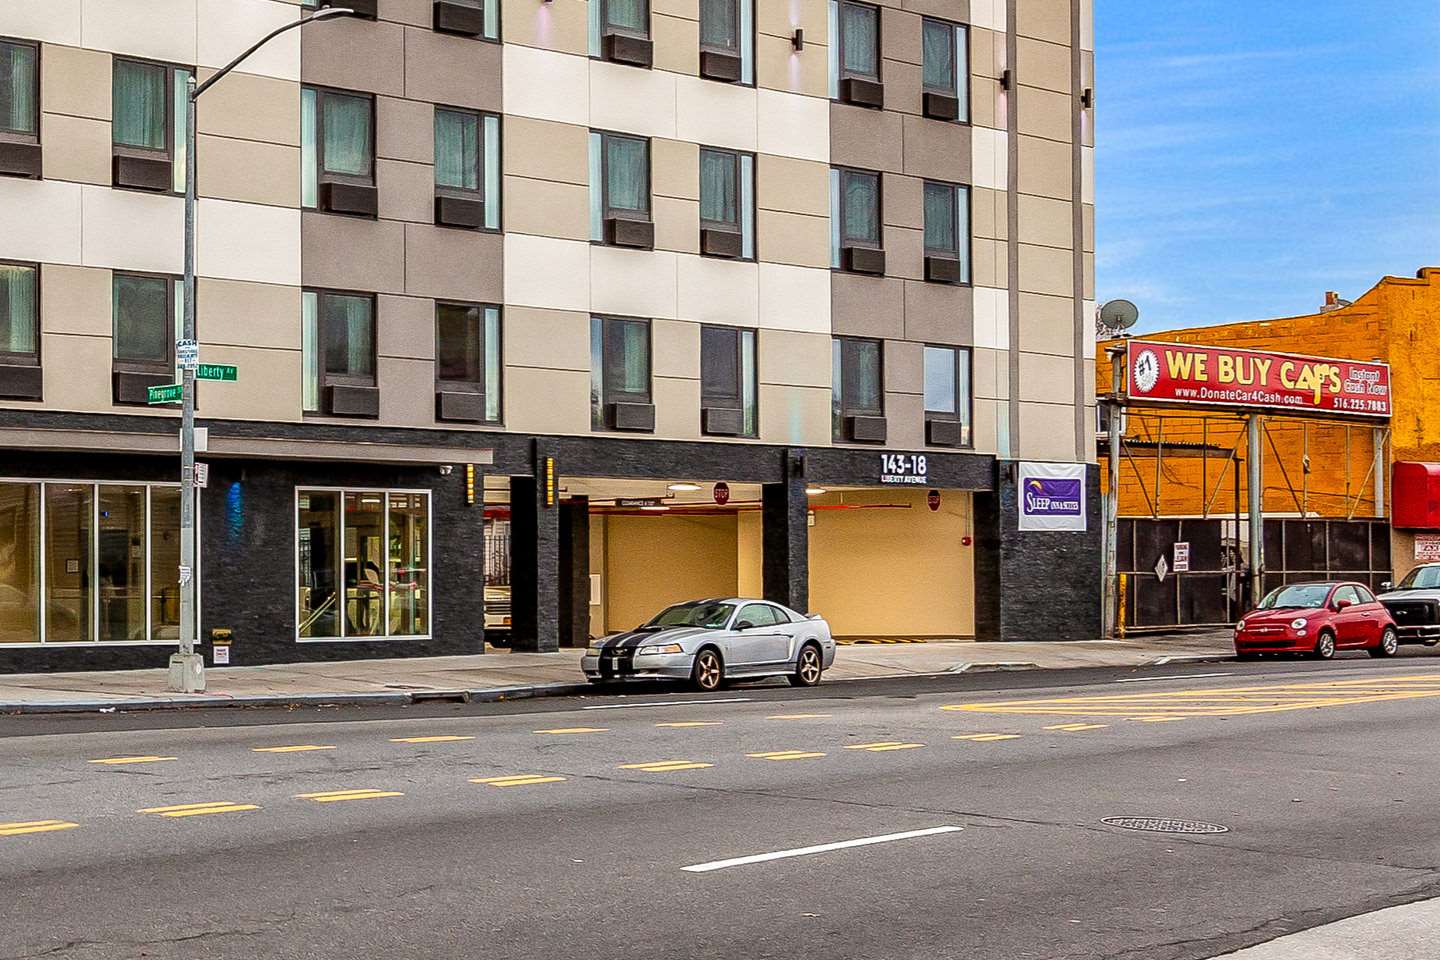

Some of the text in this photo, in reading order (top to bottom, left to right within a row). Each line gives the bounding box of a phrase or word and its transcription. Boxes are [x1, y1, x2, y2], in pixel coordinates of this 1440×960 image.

[197, 365, 224, 381] Liberty
[1138, 355, 1152, 376] #1
[1164, 350, 1208, 381] WE
[1217, 354, 1272, 386] BUY
[1348, 367, 1380, 381] Instant
[1343, 378, 1388, 395] Cash Now
[1174, 387, 1303, 404] www.DonateCar4Cash.com
[881, 454, 927, 475] 143-18
[881, 475, 927, 484] LIBERTY AVENUE
[715, 489, 728, 498] STOP
[1026, 492, 1050, 512] SLEEP
